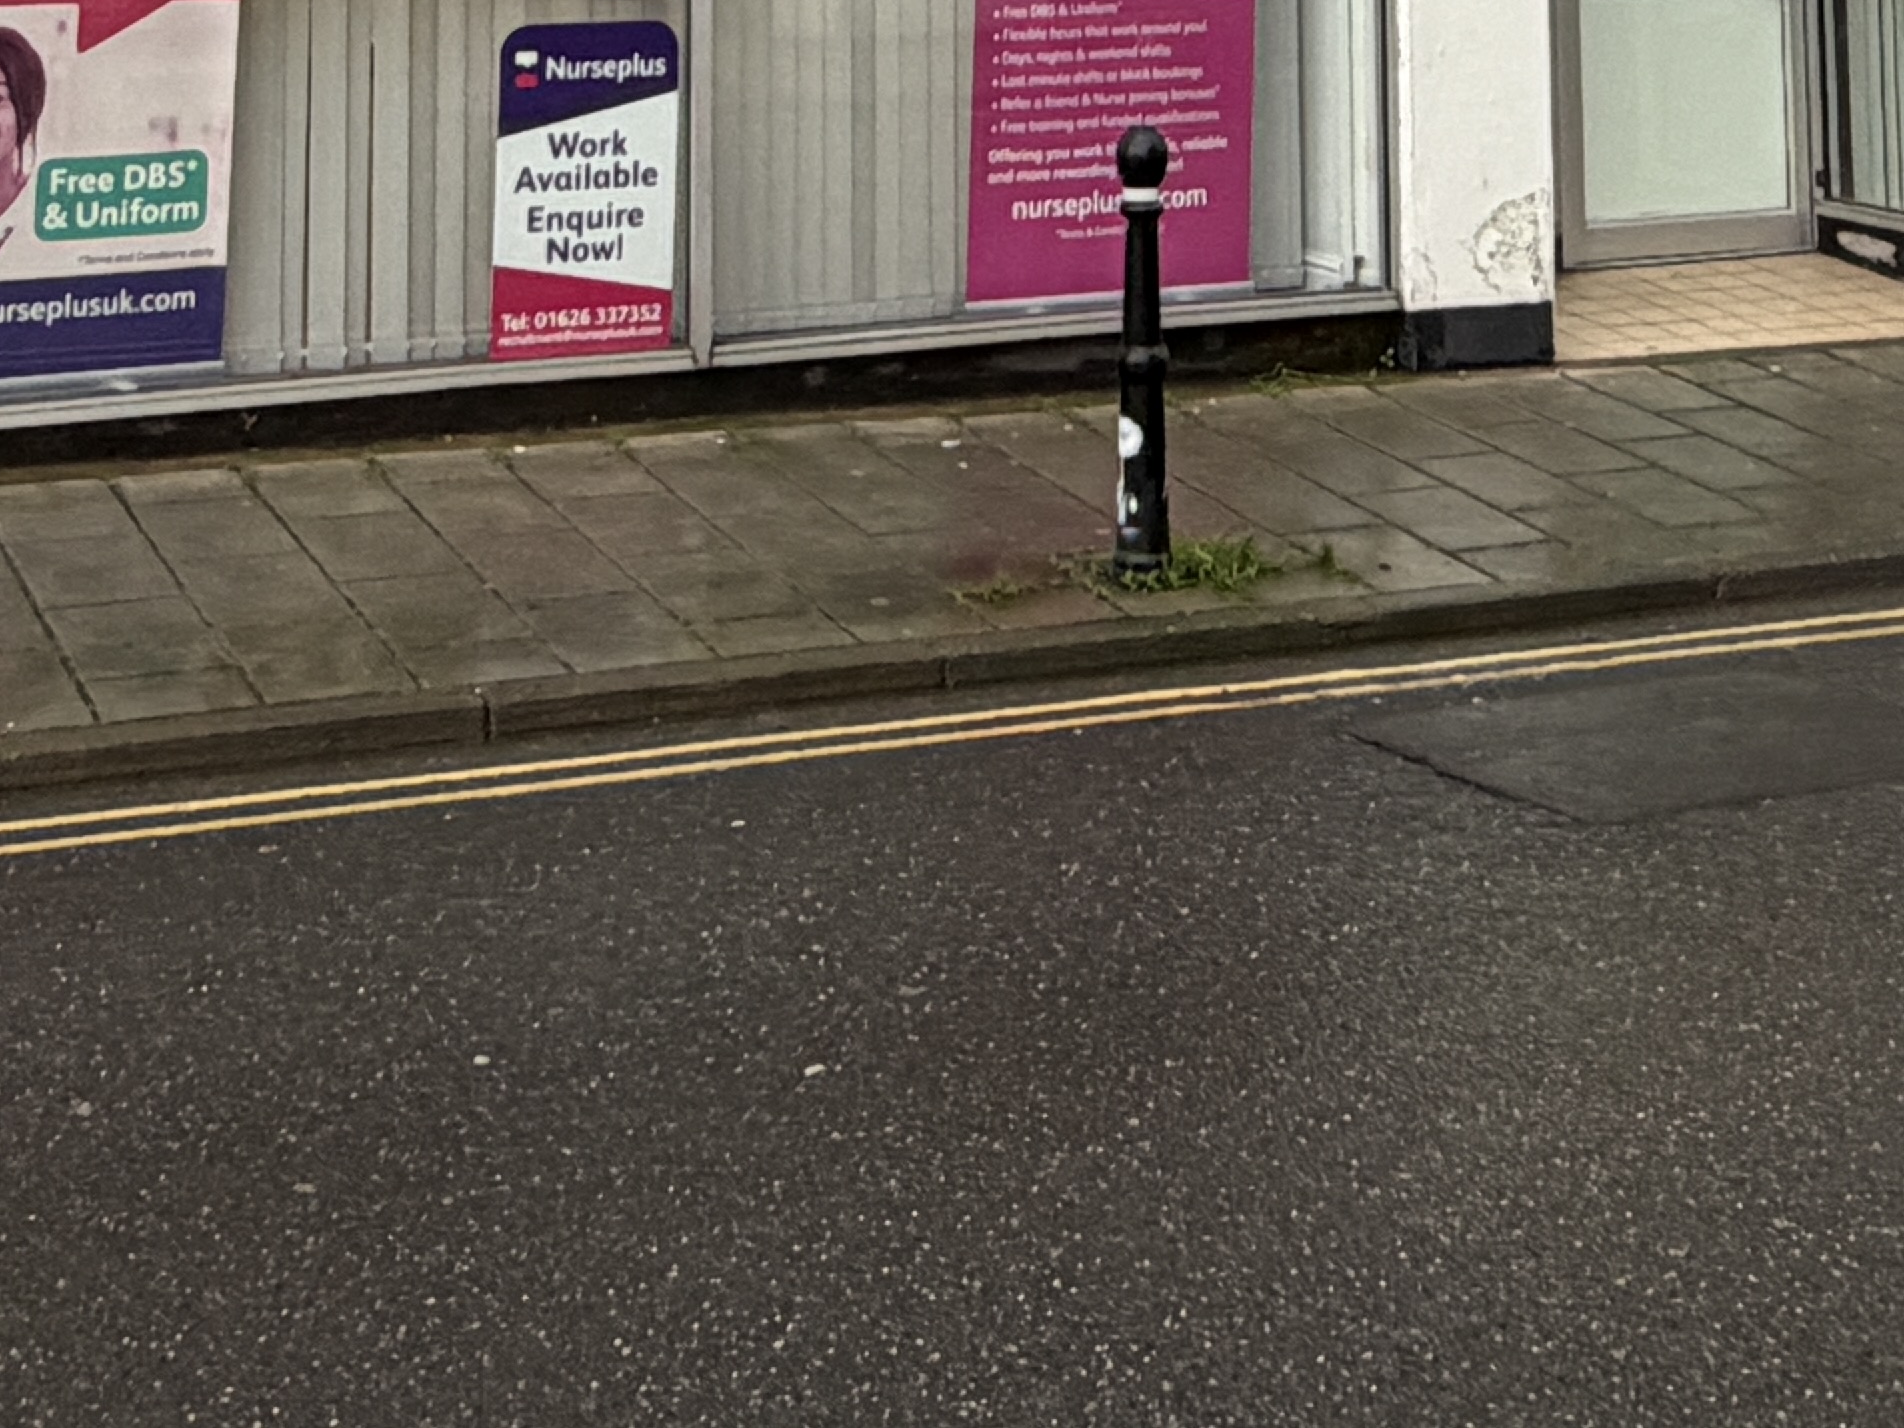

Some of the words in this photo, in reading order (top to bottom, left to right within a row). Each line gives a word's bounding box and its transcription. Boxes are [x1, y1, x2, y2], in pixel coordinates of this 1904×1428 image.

[546, 53, 667, 83] Nurseplus
[548, 129, 627, 159] Work
[49, 167, 114, 196] Free
[514, 160, 658, 193] Available
[42, 202, 68, 230] &
[75, 197, 199, 228] Uniform
[527, 202, 644, 238] Enquire
[546, 234, 623, 264] Now!
[501, 312, 530, 332] Tel:
[534, 307, 591, 329] 01626
